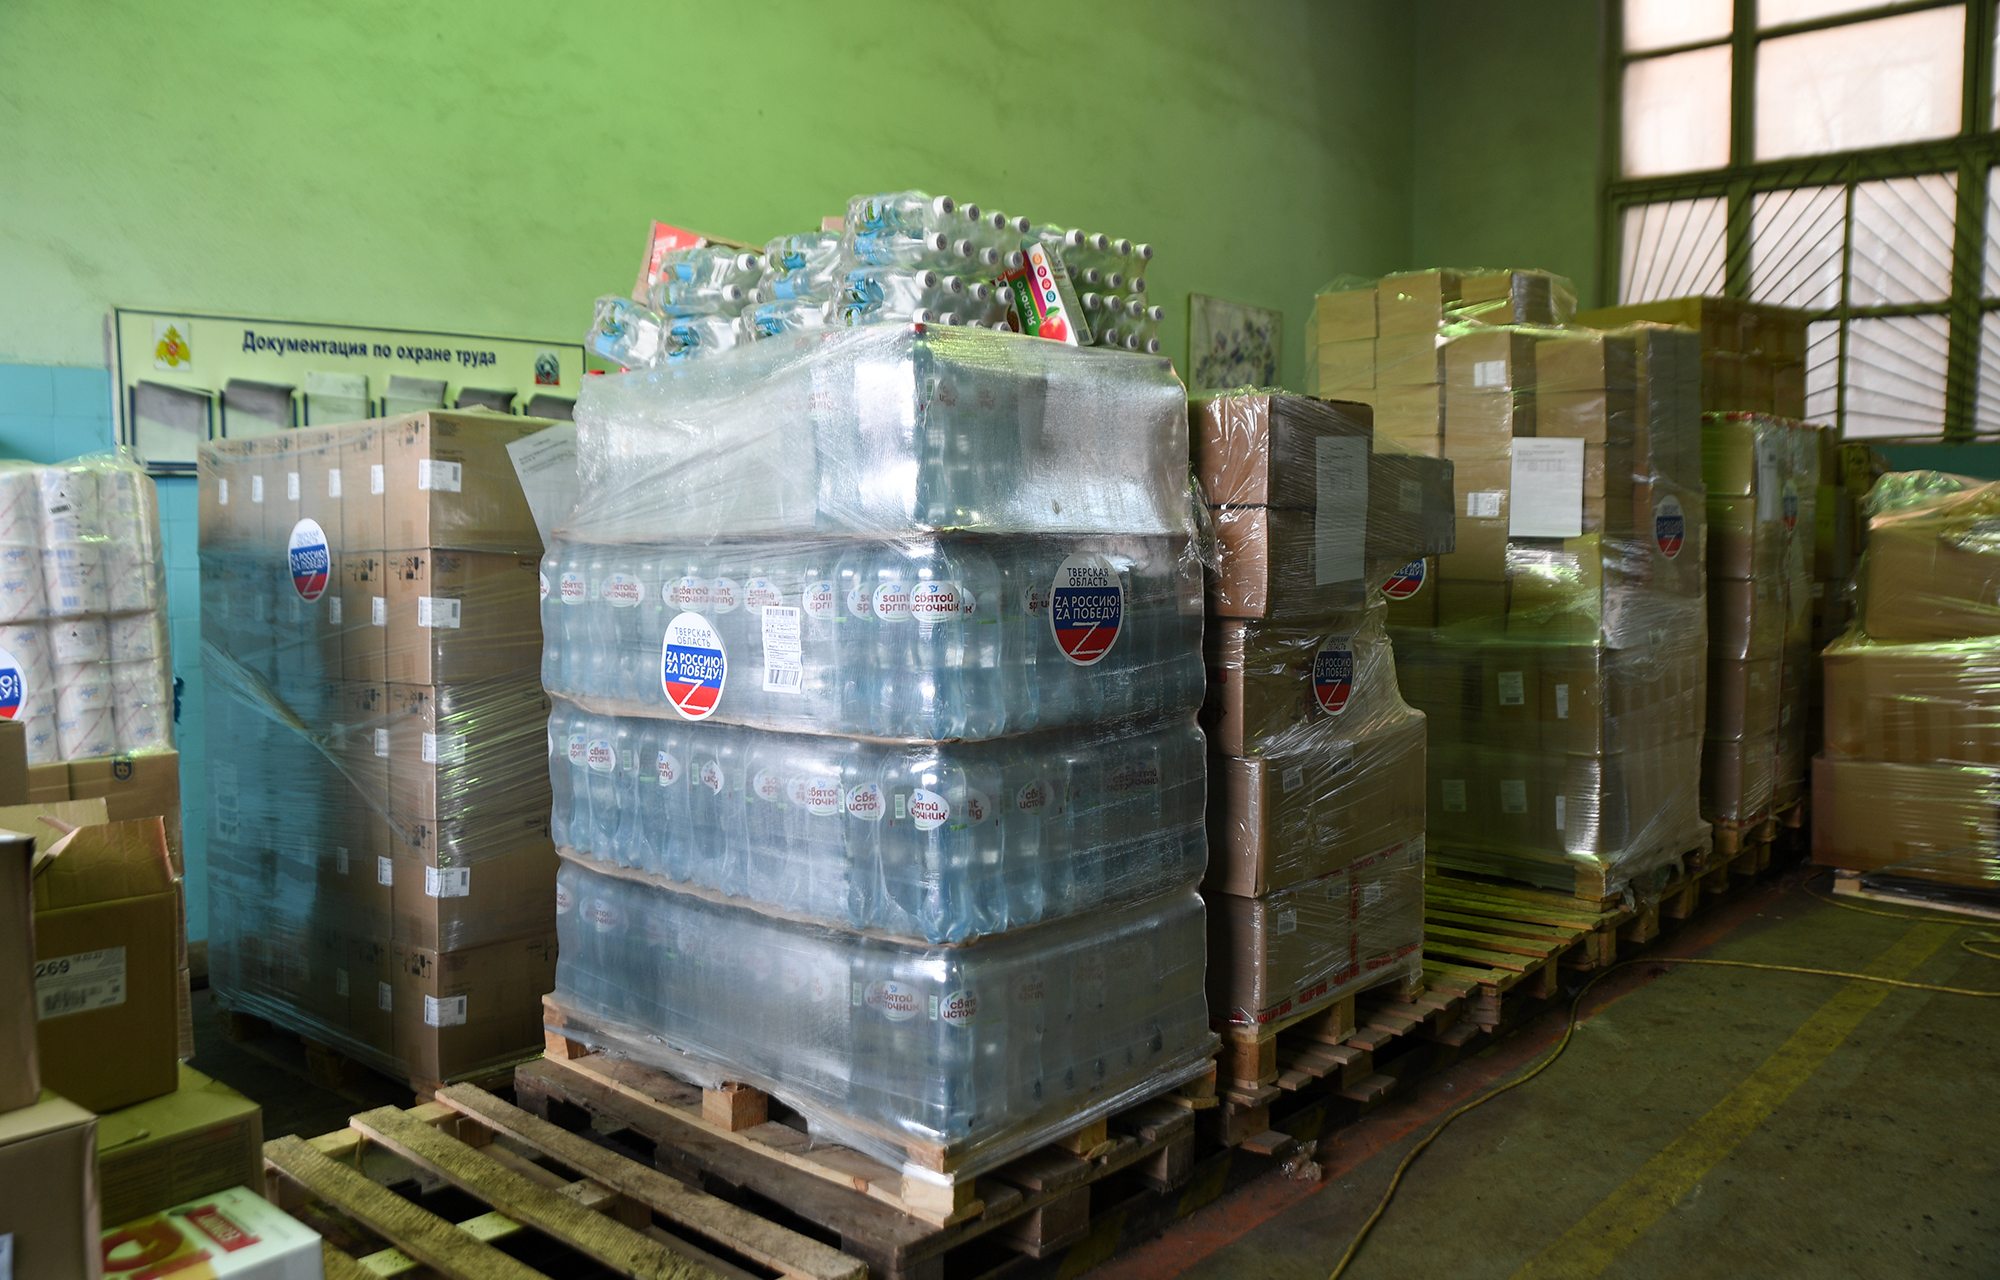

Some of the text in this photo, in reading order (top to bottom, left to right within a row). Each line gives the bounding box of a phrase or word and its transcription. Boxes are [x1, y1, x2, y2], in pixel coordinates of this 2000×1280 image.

[242, 329, 496, 367] Документация по охране труда
[1066, 567, 1109, 577] ТВЕРСКАЯ
[1069, 577, 1108, 586] ОБЛАСТЬ
[914, 593, 953, 602] святой
[674, 627, 711, 638] ТВЕРСКАЯ
[677, 636, 711, 647] ОБЛАСТЬ
[1070, 621, 1104, 656] Z
[679, 676, 710, 711] Z
[807, 797, 838, 806] сточн
[914, 801, 939, 811] ятой
[950, 998, 976, 1010] свят
[943, 1008, 977, 1018] источ
